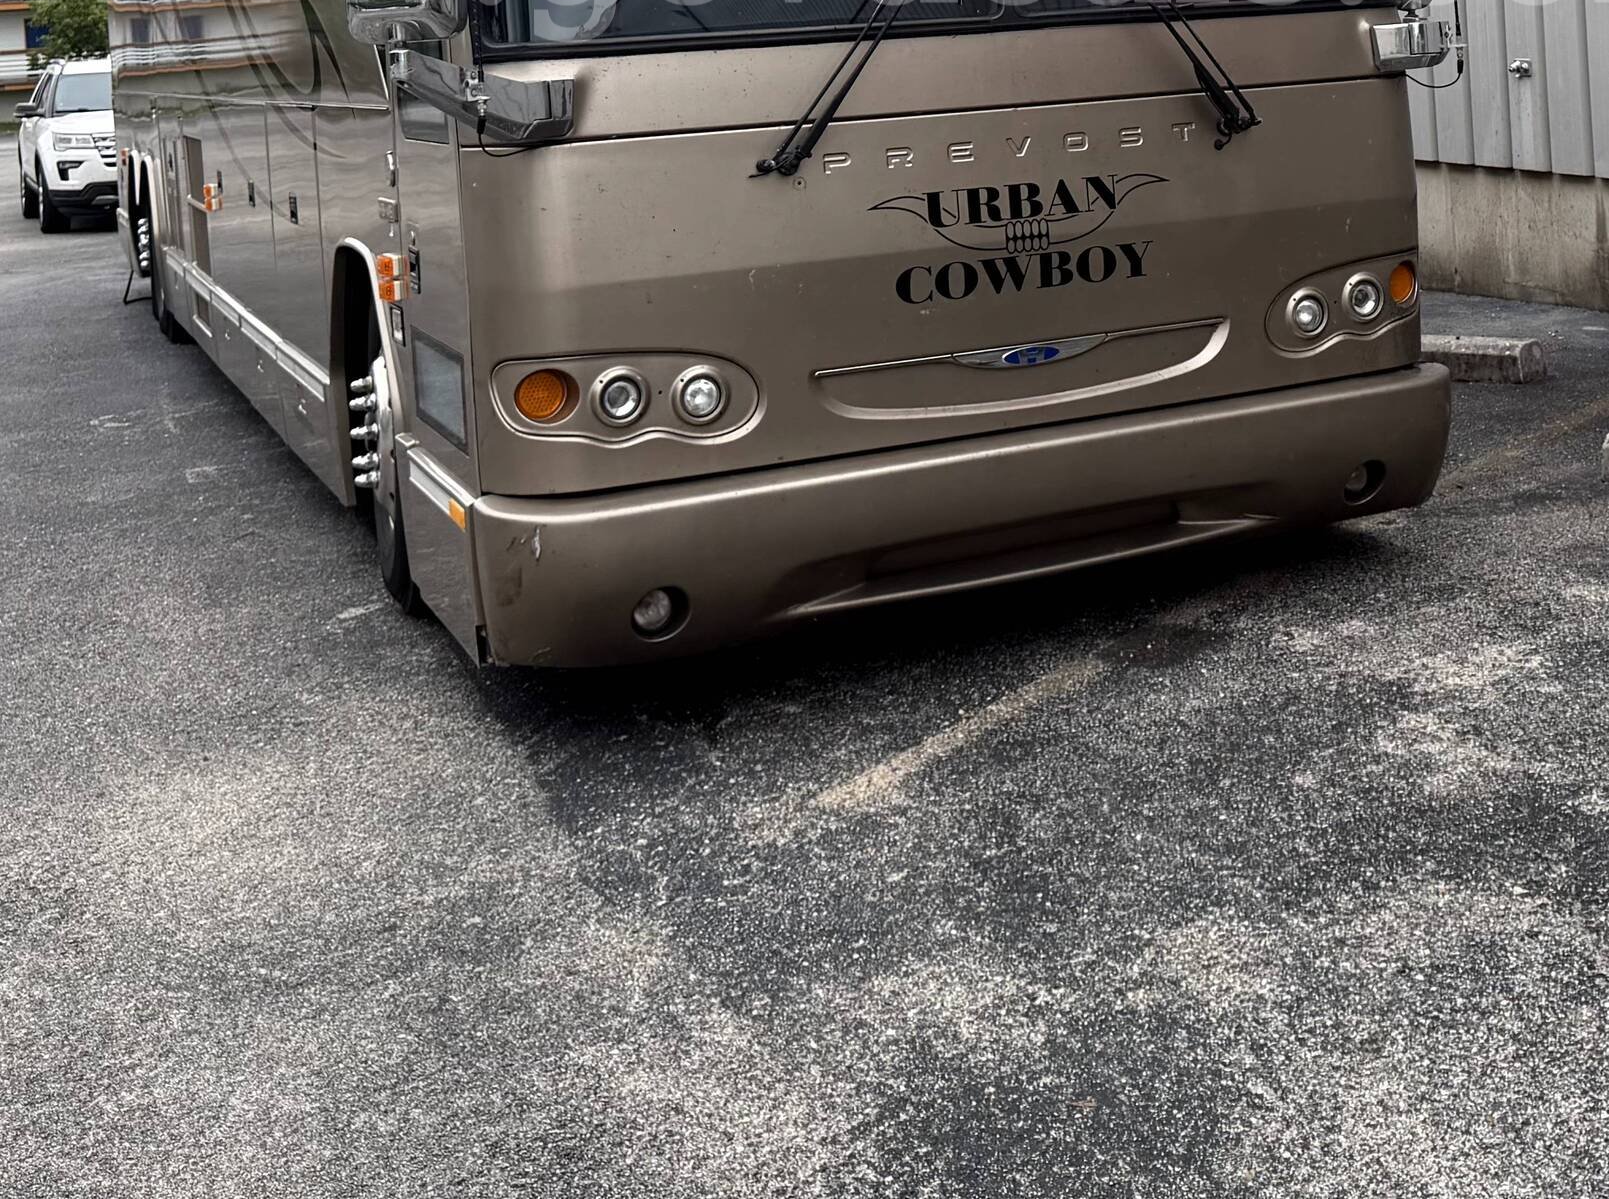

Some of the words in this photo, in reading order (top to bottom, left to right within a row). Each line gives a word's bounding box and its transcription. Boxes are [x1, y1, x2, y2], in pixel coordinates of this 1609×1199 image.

[822, 122, 1196, 175] PREVOST
[923, 175, 1119, 228] URBAN
[895, 240, 1154, 304] COWBOY
